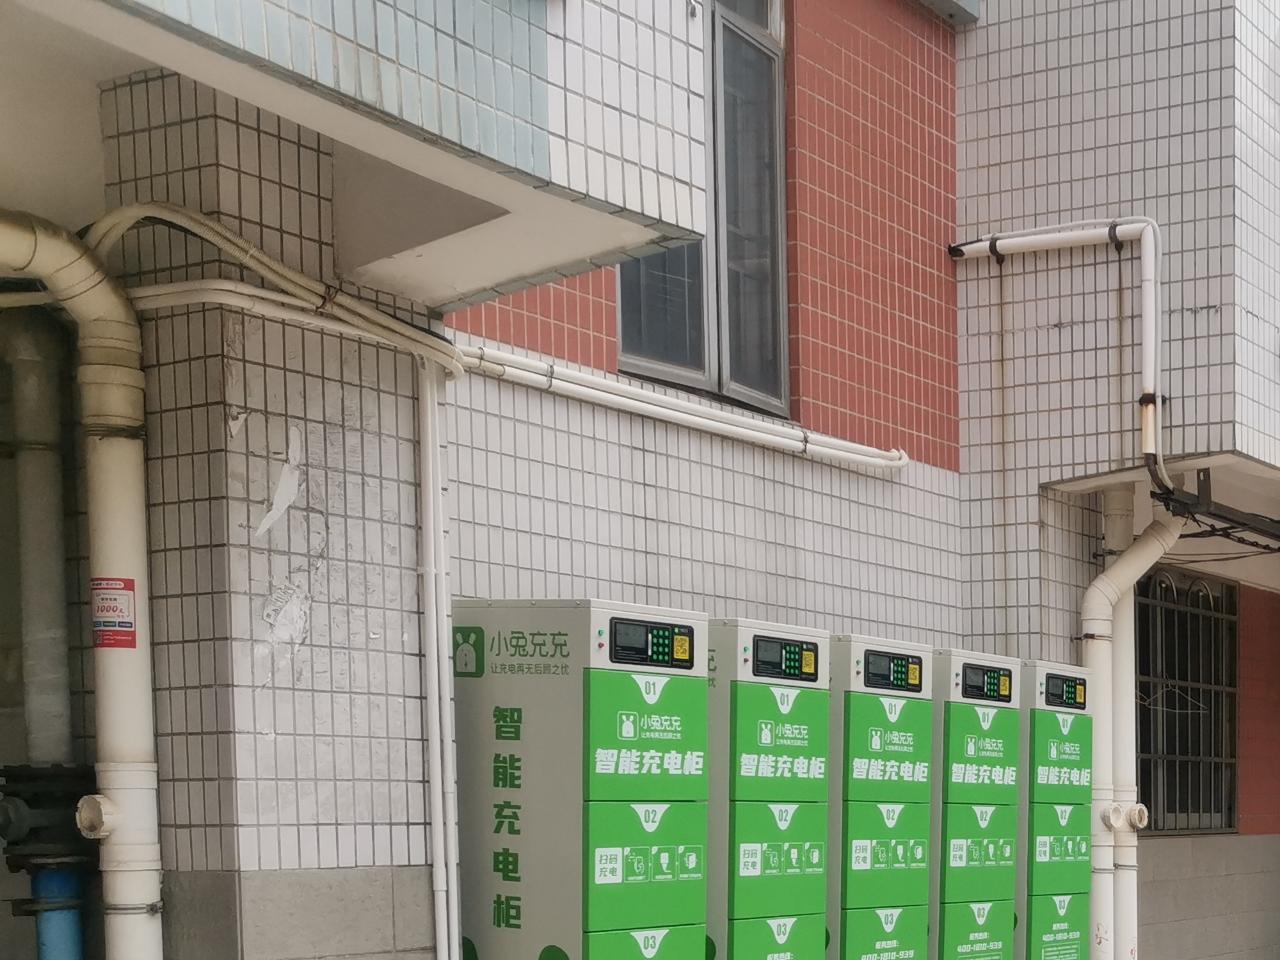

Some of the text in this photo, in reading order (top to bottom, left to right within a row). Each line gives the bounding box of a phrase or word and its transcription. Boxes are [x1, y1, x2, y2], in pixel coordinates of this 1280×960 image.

[489, 630, 570, 658] 小兔充充
[489, 663, 570, 676] 让充电再无后顾之忧
[645, 681, 656, 695] 01
[780, 693, 789, 706] 01
[888, 702, 897, 715] 01
[641, 714, 682, 731] 小兔充充
[982, 712, 989, 723] 01
[776, 723, 808, 739] 小兔充充
[885, 731, 913, 745] 小兔充充
[595, 748, 704, 775] 智能充电柜
[740, 753, 825, 778] 智能充电柜
[852, 757, 928, 782] 智能充电柜
[951, 763, 1017, 785] 智能充电柜
[1037, 765, 1091, 785] 智能充电柜
[493, 706, 522, 930] 智能充电柜
[644, 809, 657, 823] 02
[778, 809, 788, 822] 02
[886, 809, 895, 820] 02
[599, 854, 618, 865] 扫码
[599, 867, 618, 877] 充电
[884, 914, 894, 925] 03
[777, 923, 787, 936] 03
[643, 936, 656, 950] 03
